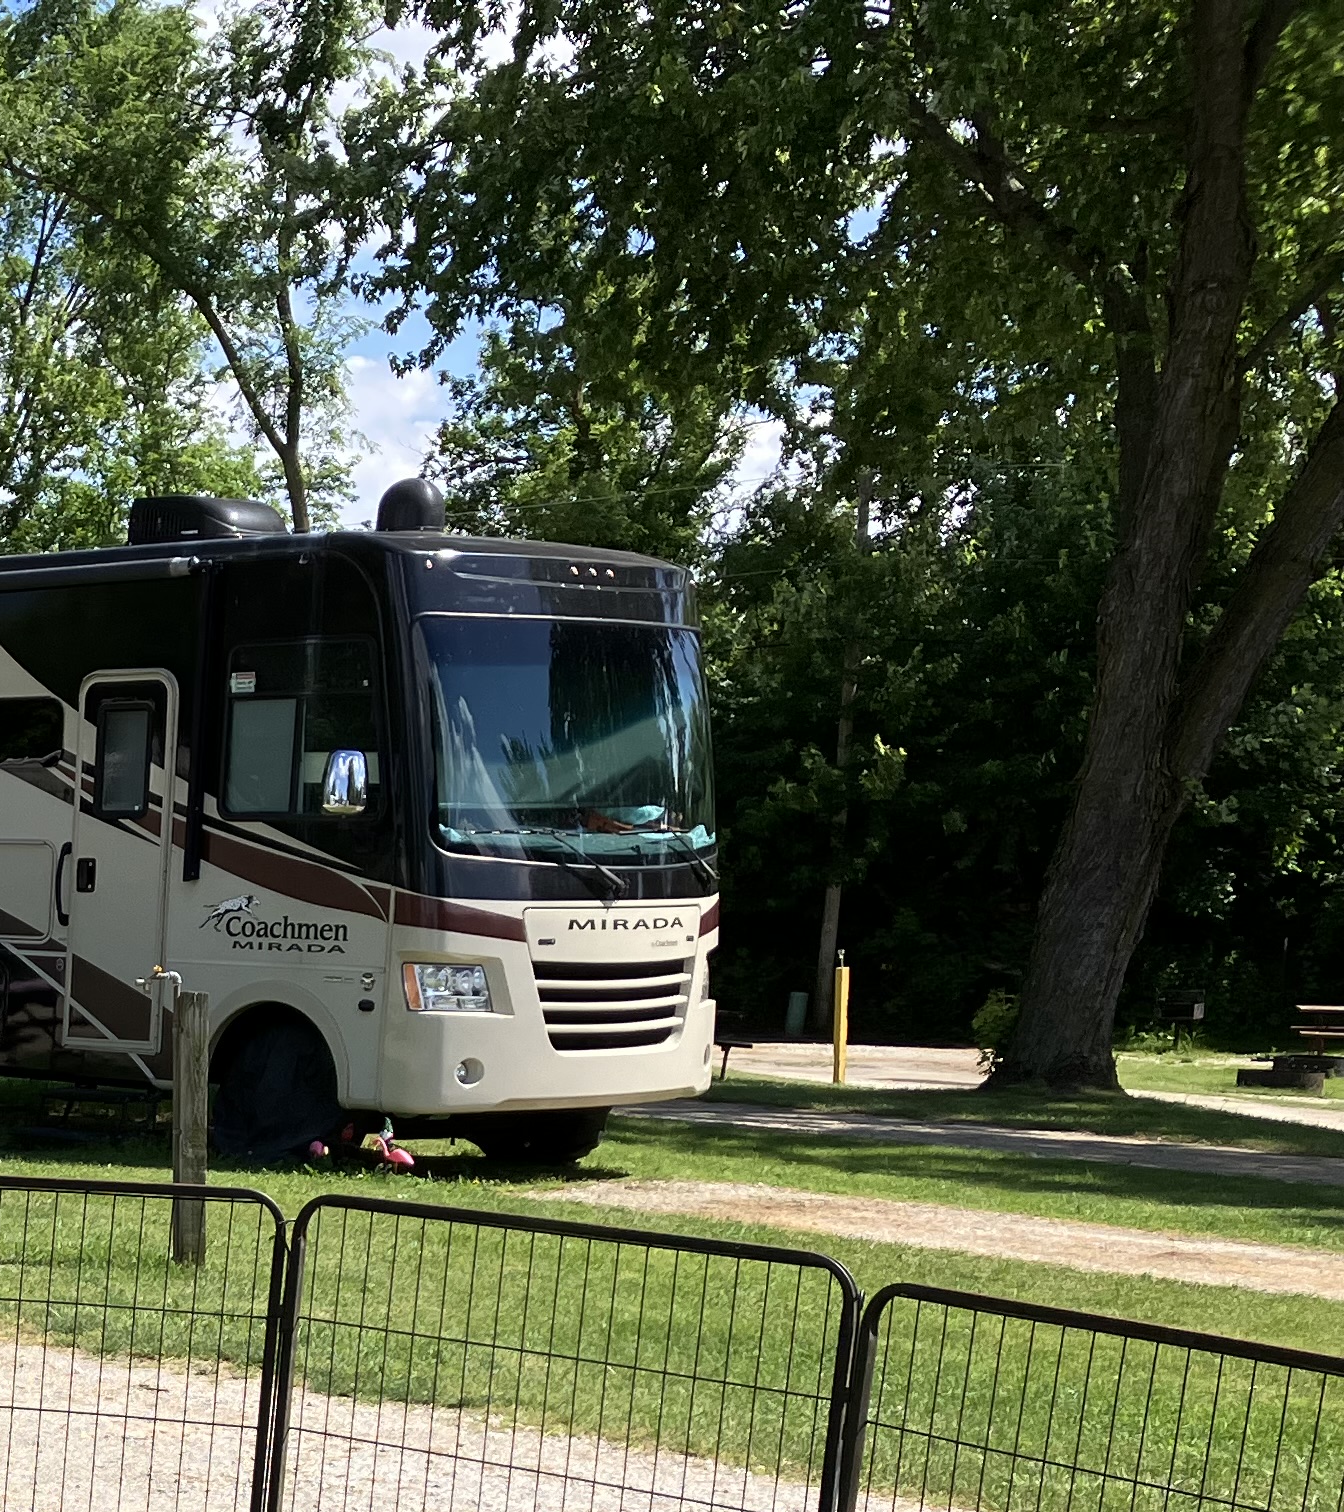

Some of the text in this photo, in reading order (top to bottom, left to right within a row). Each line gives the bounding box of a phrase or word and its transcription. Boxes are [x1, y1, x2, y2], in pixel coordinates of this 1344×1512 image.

[225, 915, 348, 942] Coachmen
[567, 916, 684, 931] MIRADA
[232, 940, 346, 954] MIRADA
